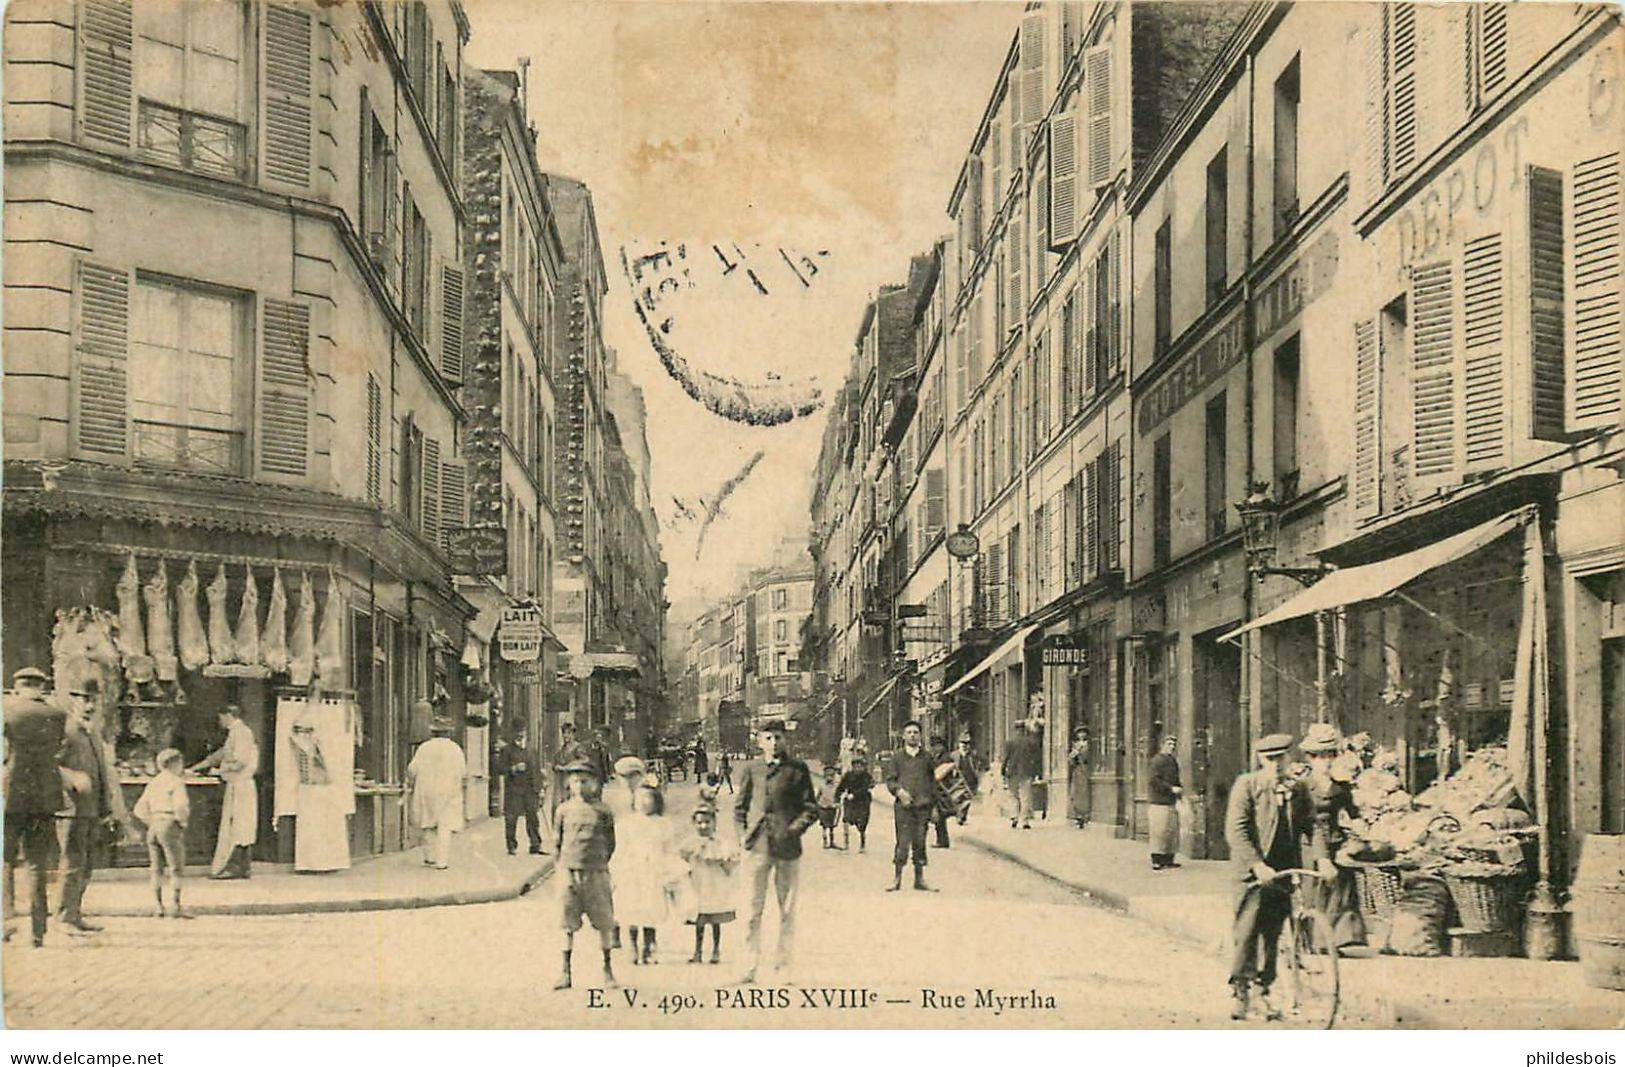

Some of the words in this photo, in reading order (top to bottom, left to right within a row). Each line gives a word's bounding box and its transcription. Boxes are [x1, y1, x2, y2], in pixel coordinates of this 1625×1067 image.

[504, 610, 536, 622] LAIT
[520, 642, 537, 650] LAIT
[1042, 648, 1087, 663] GIRONDE
